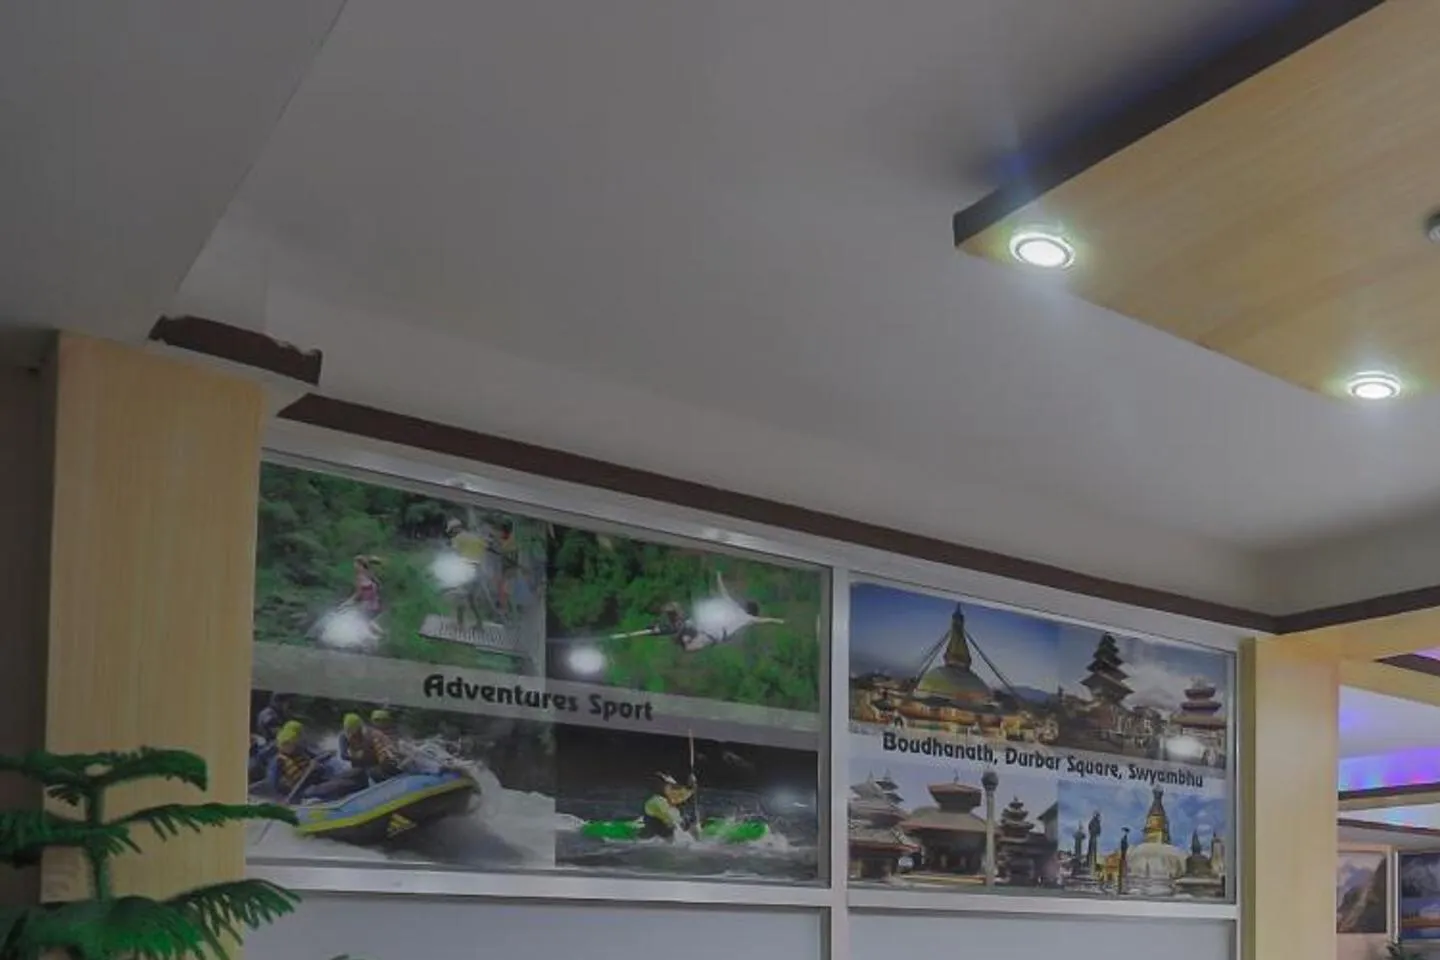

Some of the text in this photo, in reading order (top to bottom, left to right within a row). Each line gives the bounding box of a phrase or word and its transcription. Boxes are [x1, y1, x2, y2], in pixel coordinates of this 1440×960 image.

[423, 674, 654, 721] Adventures Sport
[882, 732, 1204, 788] Boudhanath, Durbar Square, Swyambhu
